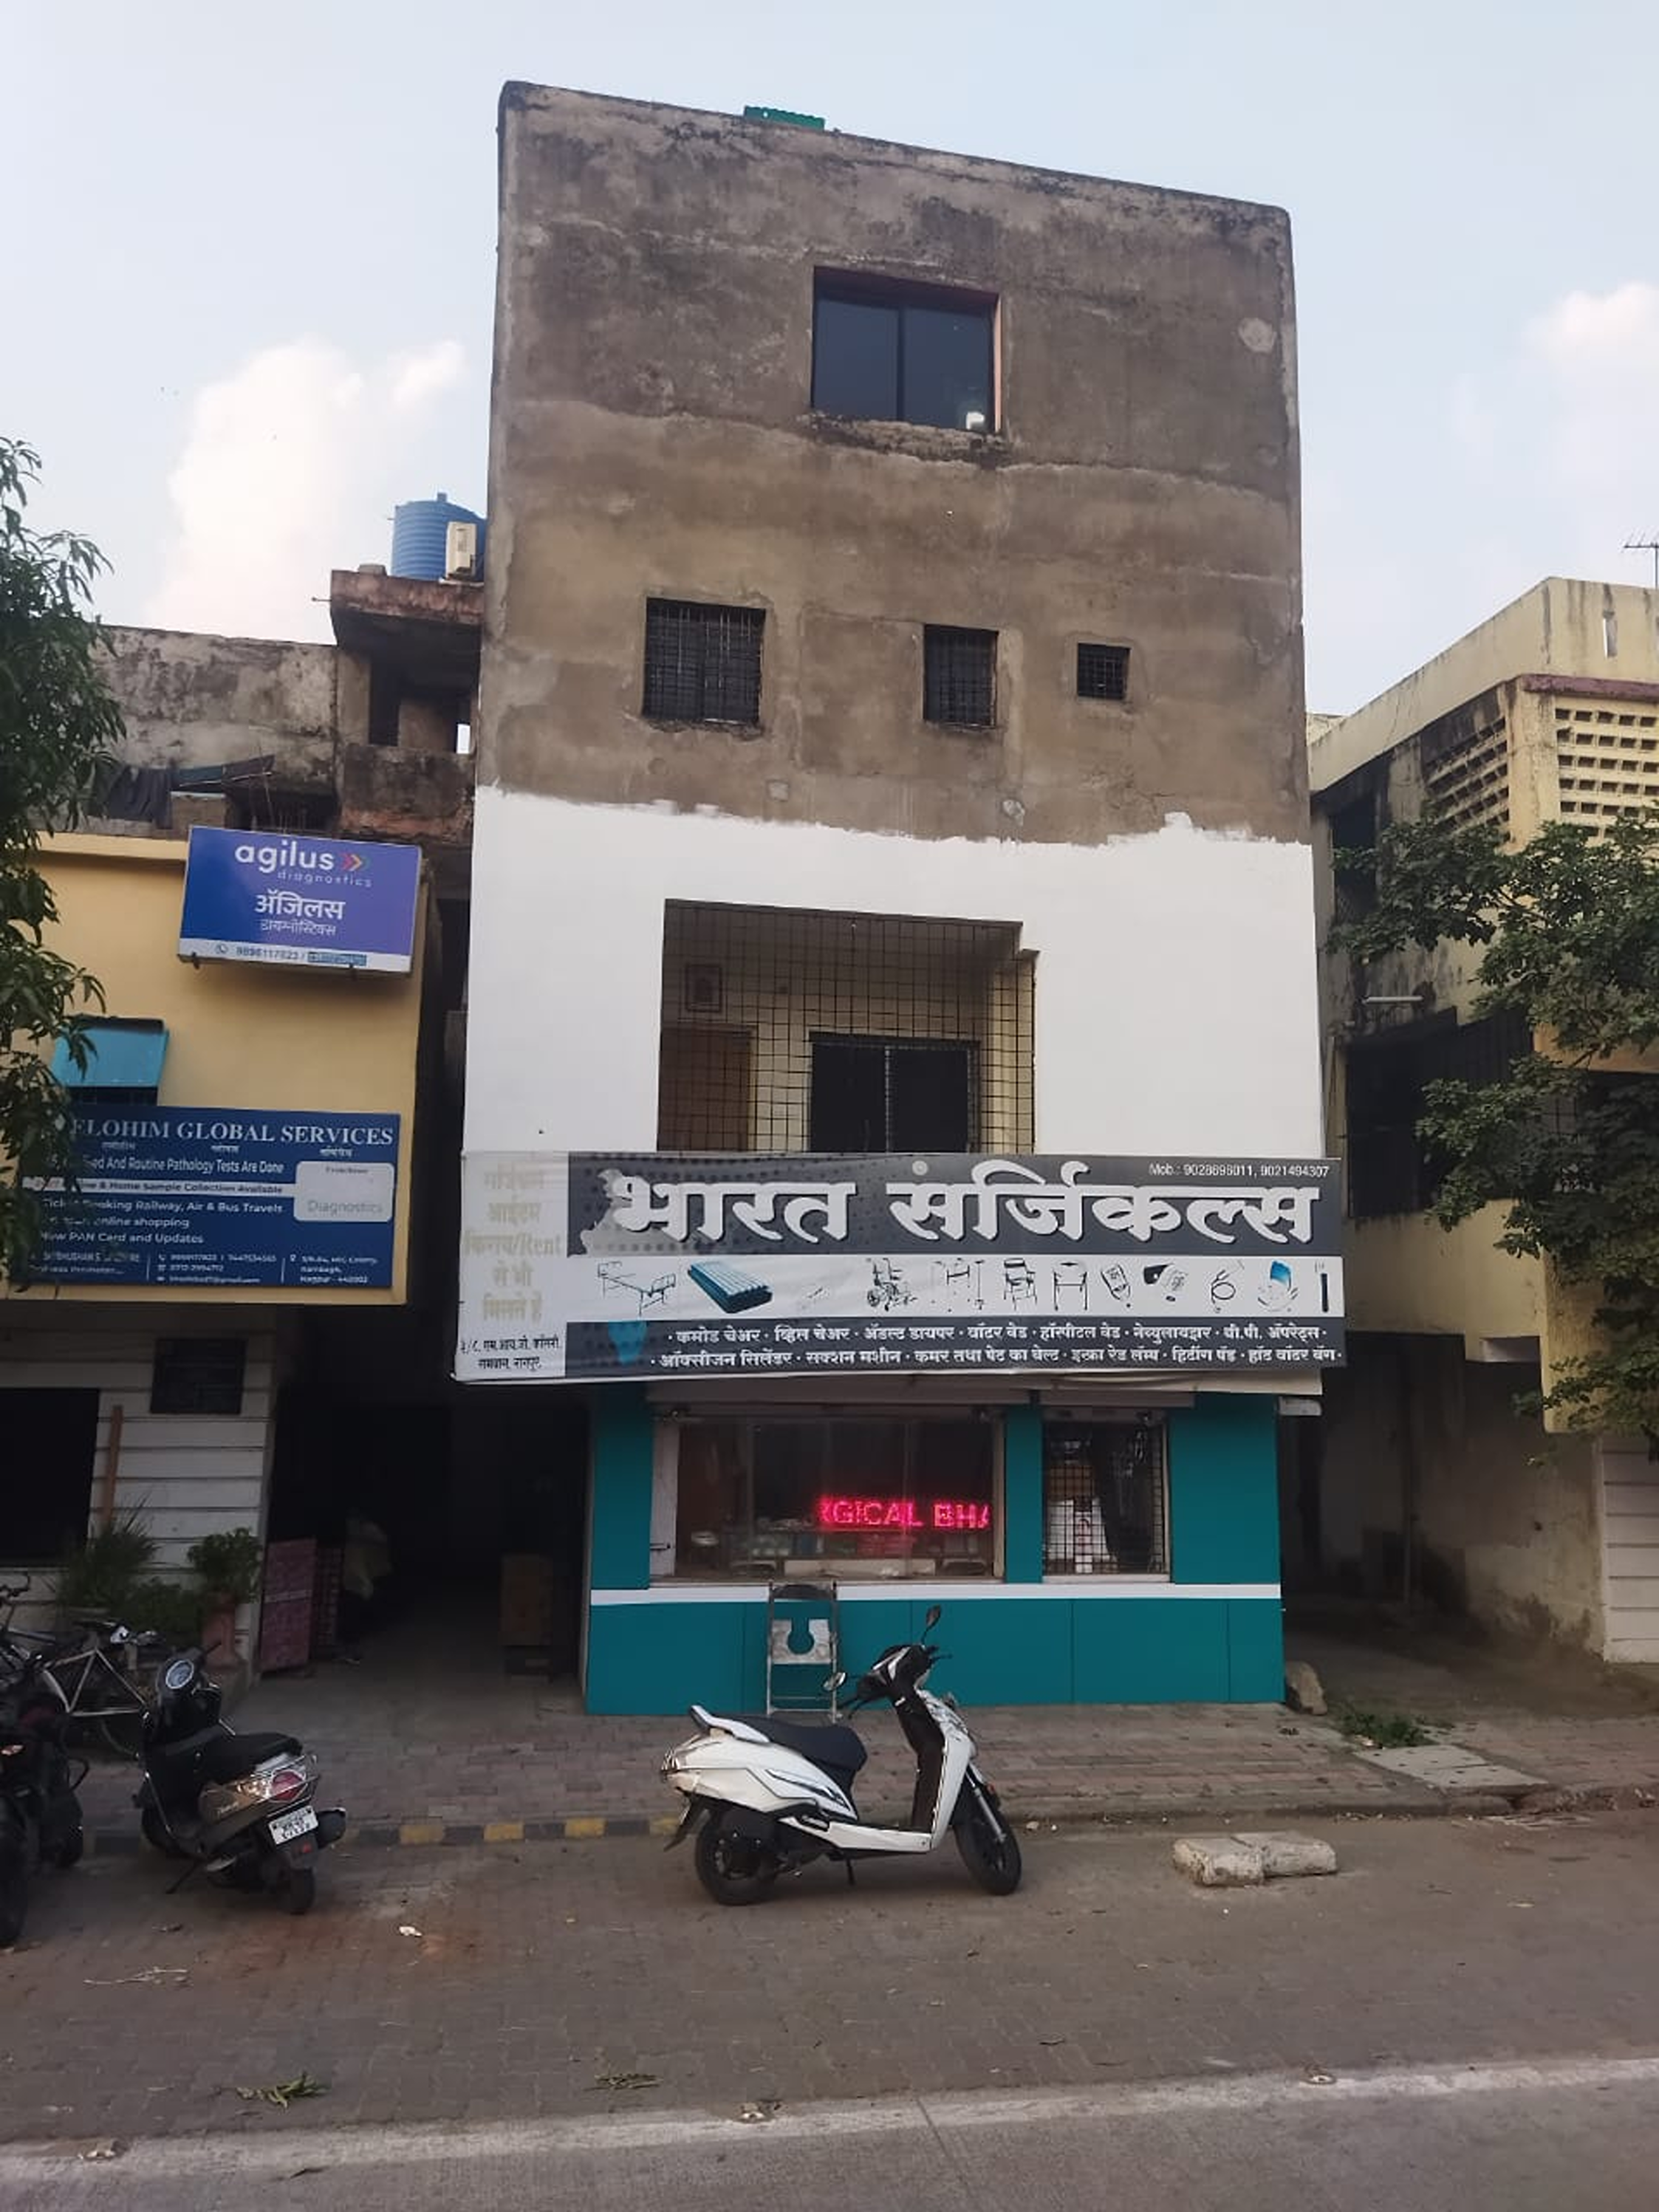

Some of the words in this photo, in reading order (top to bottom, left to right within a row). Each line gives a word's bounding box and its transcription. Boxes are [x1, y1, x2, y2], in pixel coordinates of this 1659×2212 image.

[235, 840, 335, 873] agilus
[277, 870, 372, 888] diagnostics
[177, 1122, 275, 1142] GLOBAL
[281, 1126, 393, 1146] SERVICES
[105, 1157, 126, 1170] And
[129, 1157, 165, 1171] Routine
[167, 1157, 214, 1175] Pathology
[216, 1159, 239, 1173] Tests
[241, 1161, 258, 1173] Are
[259, 1161, 284, 1174] Done
[143, 1182, 182, 1193] Sample
[185, 1182, 236, 1192] Collection
[135, 1199, 184, 1213] Railway,
[187, 1202, 203, 1212] Air
[218, 1202, 240, 1213] Bus
[243, 1203, 283, 1213] Travels
[609, 1176, 857, 1244] भारत
[134, 1216, 190, 1228] shopping
[69, 1231, 95, 1242] PAN
[98, 1231, 126, 1243] Card
[129, 1232, 151, 1243] and
[154, 1232, 205, 1244] Updates
[676, 1326, 719, 1343] कमोड
[724, 1325, 761, 1343] चेअर
[813, 1323, 850, 1341] चेअर
[909, 1326, 954, 1340] डायपर
[858, 1346, 902, 1364] मशीन
[913, 1350, 951, 1363] कमर
[953, 1349, 982, 1363] तथा
[985, 1344, 1005, 1362] पेट
[1008, 1349, 1028, 1361] का
[1108, 1344, 1127, 1361] रेड
